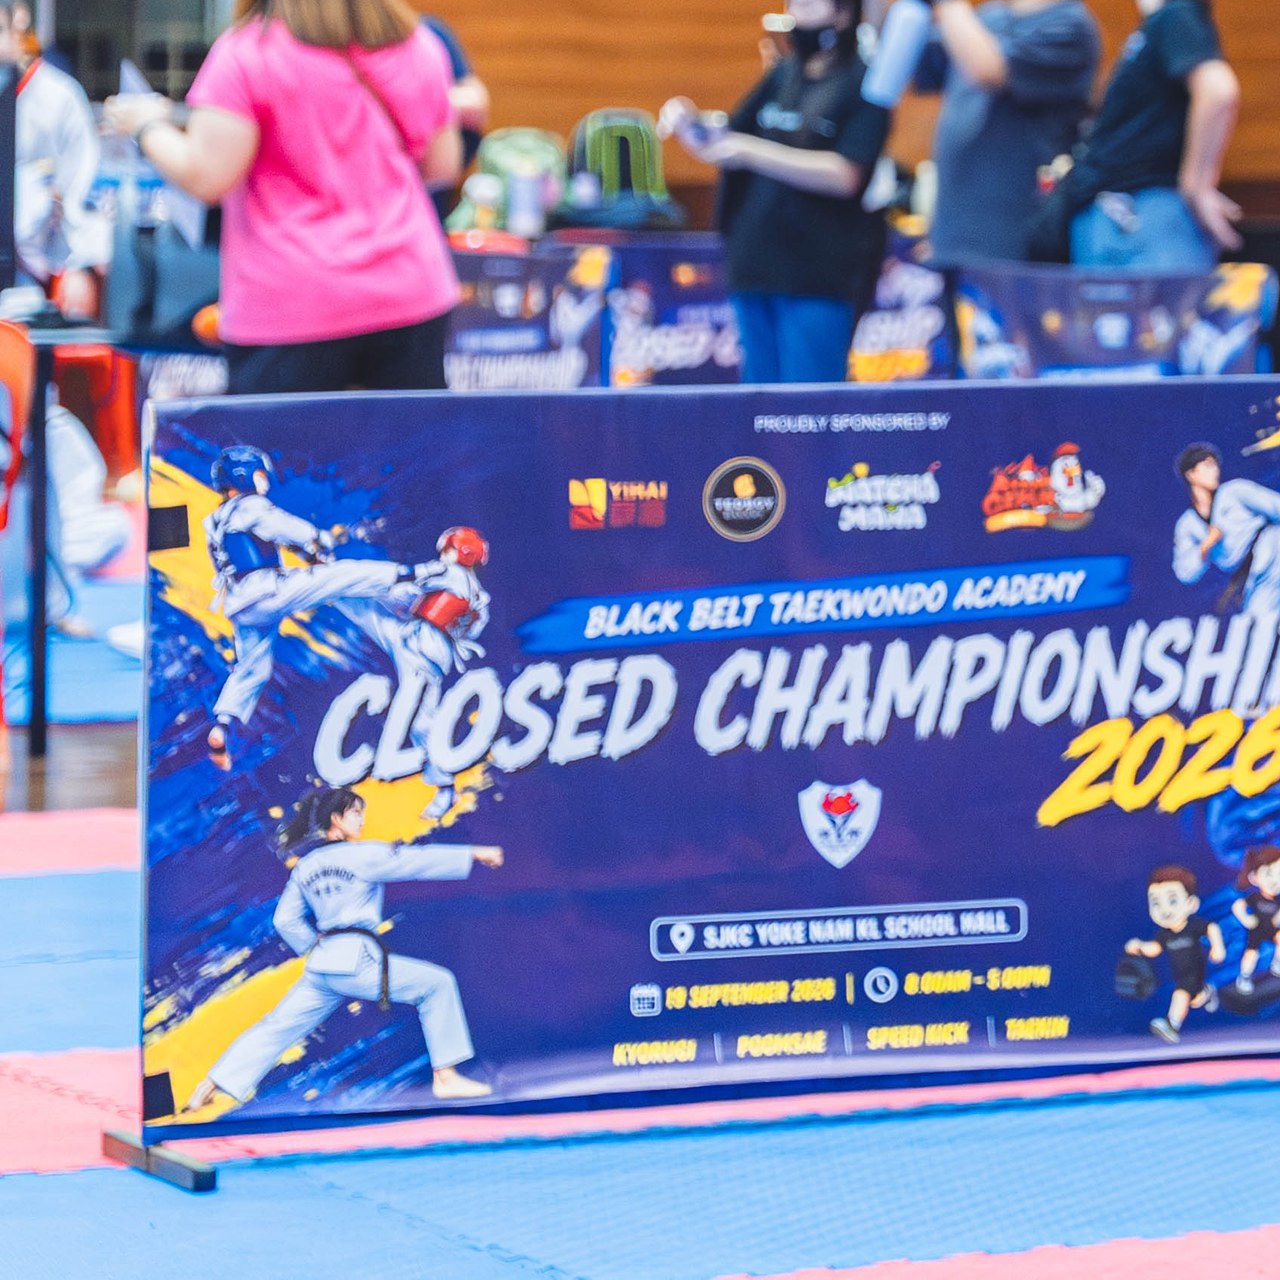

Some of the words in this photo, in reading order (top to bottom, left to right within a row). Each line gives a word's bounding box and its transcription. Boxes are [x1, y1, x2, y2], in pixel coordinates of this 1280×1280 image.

[754, 414, 828, 434] PROUDLY
[830, 412, 927, 433] SPONSORED
[928, 411, 951, 431] BY
[584, 600, 683, 639] BLACK
[688, 593, 763, 631] BELT
[769, 580, 948, 623] TAEKWONDO
[953, 570, 1086, 612] ACADEMY
[313, 653, 678, 788] CLOSED
[809, 918, 854, 943] NAM
[883, 912, 958, 939] SCHOOL
[960, 909, 1010, 935] HALL
[688, 980, 789, 1009] SEPTEMBER
